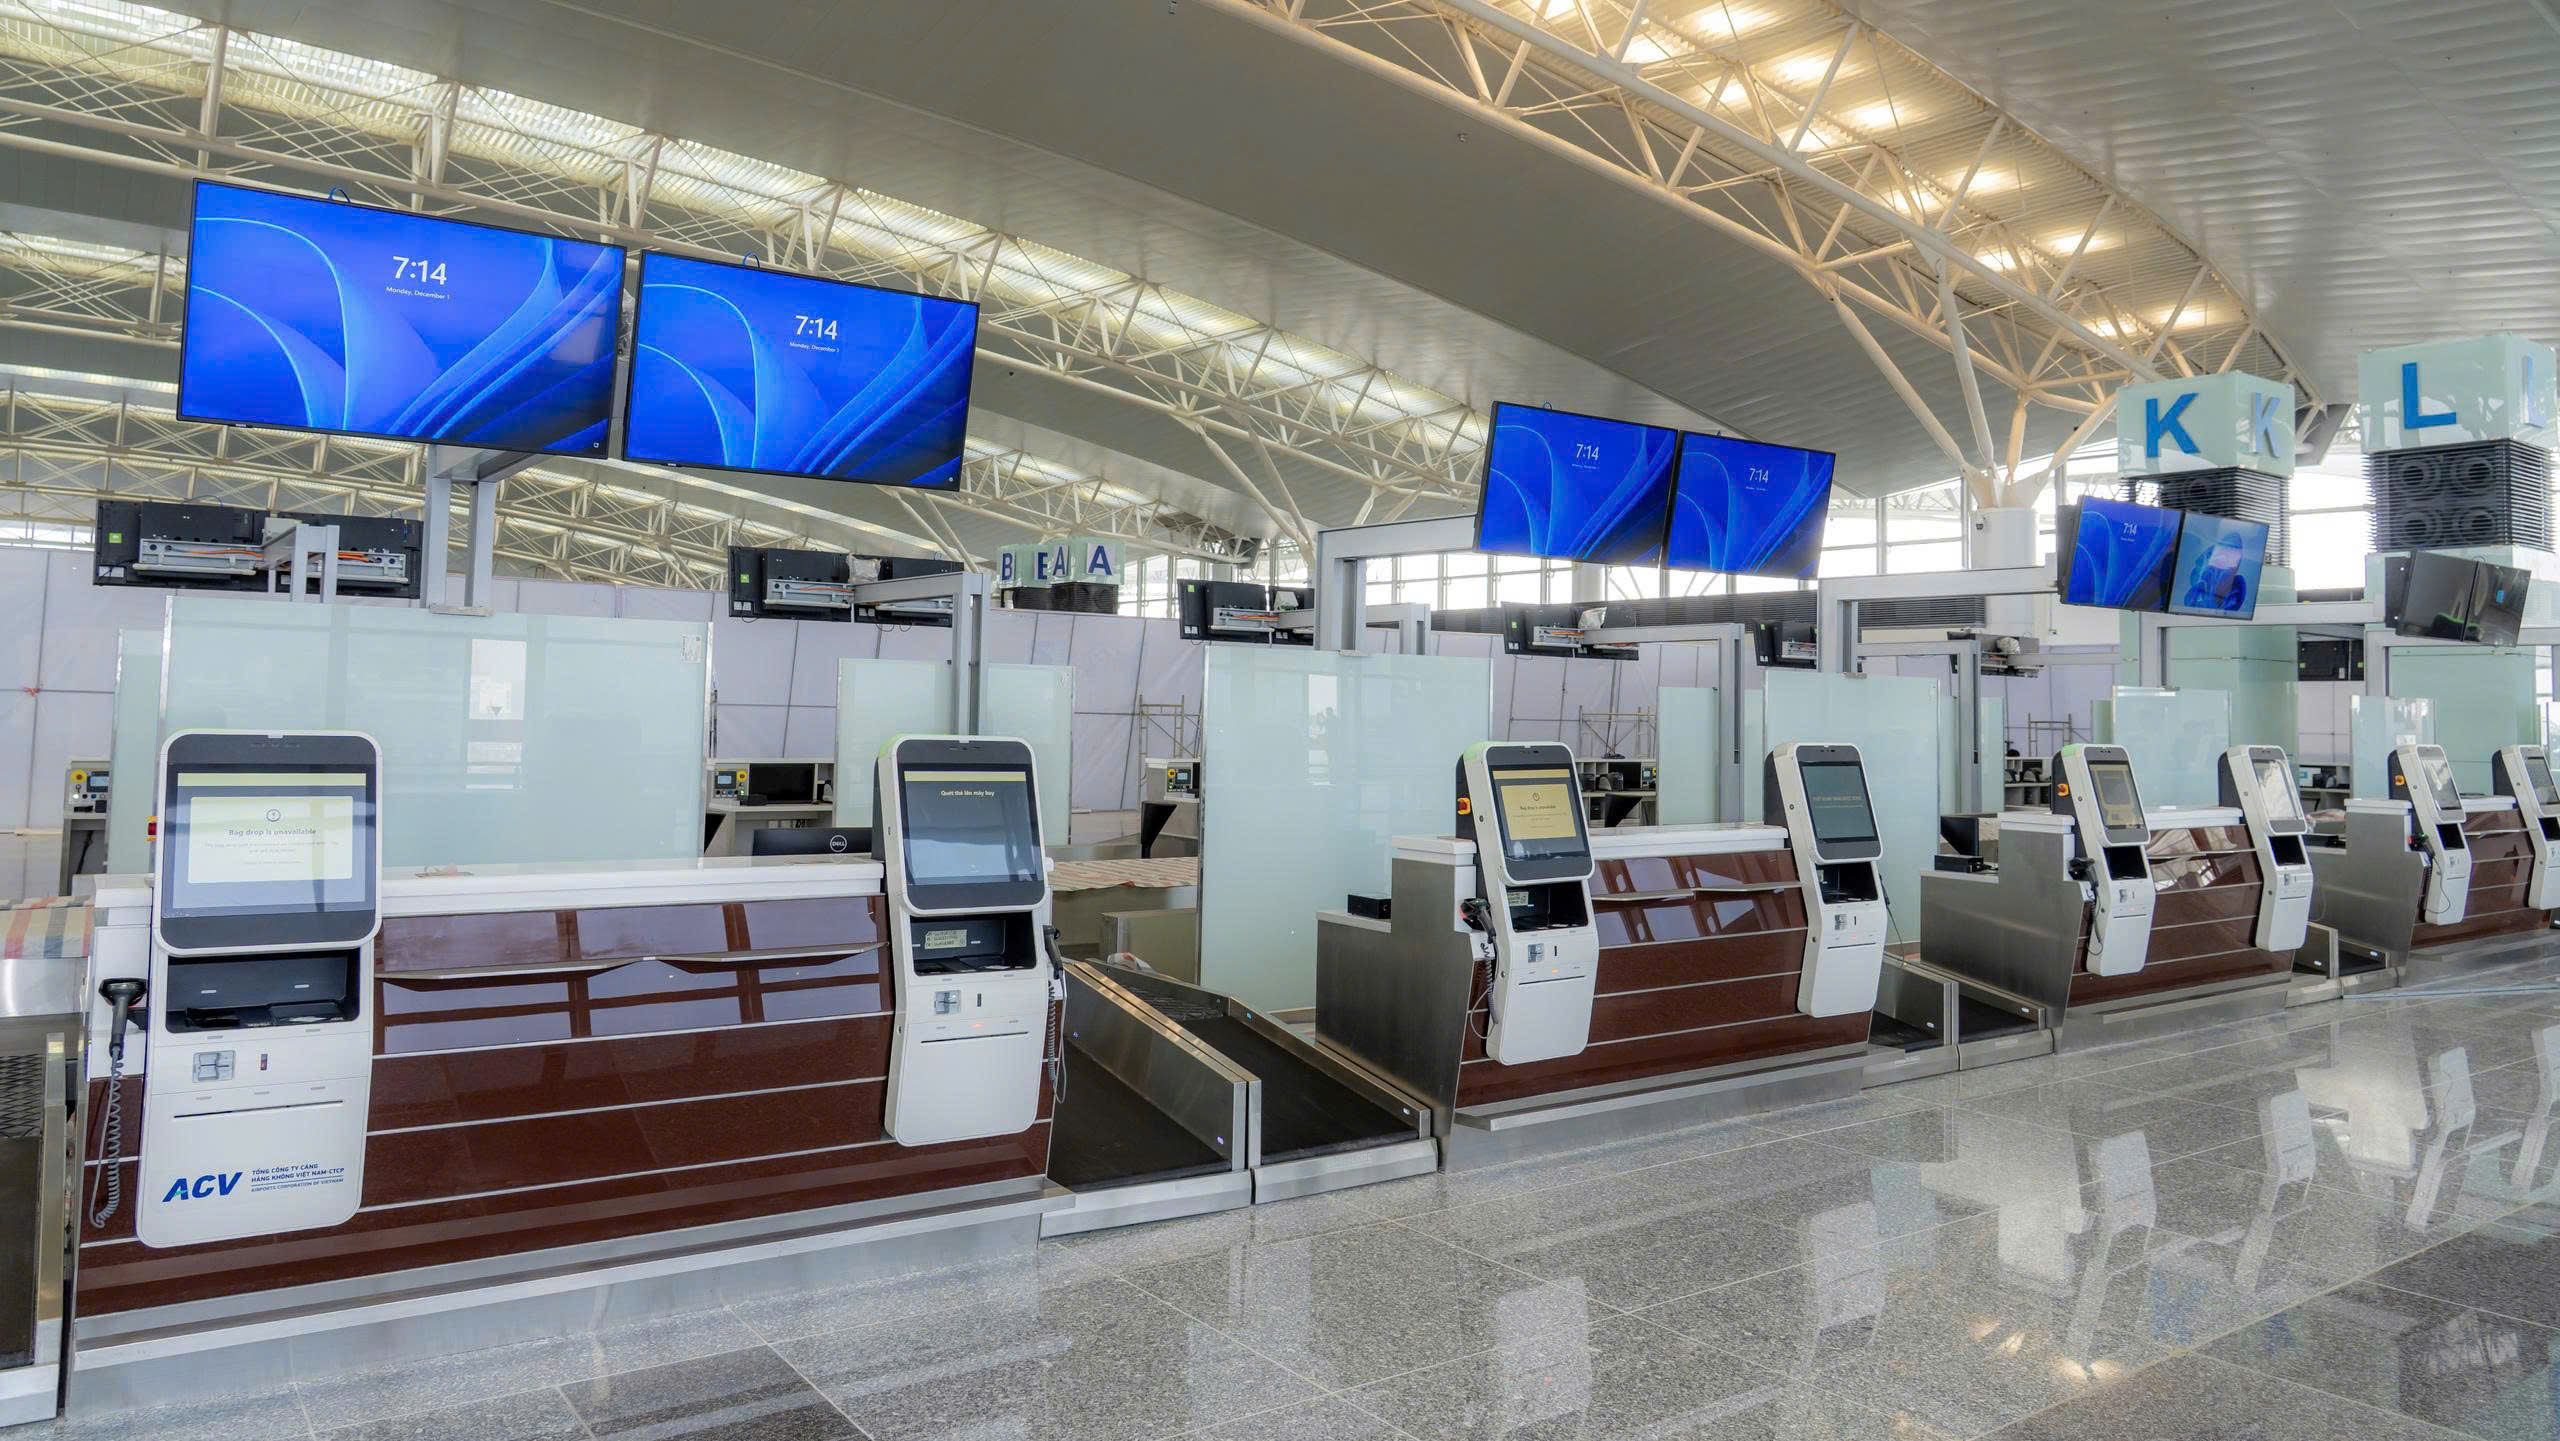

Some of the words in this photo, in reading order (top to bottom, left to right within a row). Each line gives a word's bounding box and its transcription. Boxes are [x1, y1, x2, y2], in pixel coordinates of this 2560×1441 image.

[392, 255, 447, 285] 7:14
[386, 286, 412, 296] Monday,
[414, 290, 445, 299] December
[795, 314, 838, 340] 7:14
[2402, 362, 2457, 429] L
[2146, 392, 2200, 458] K
[2251, 392, 2280, 459] K
[1576, 443, 1599, 461] 7:14
[1749, 467, 1768, 484] 7:14
[1002, 552, 1013, 580] B
[1052, 546, 1066, 576] A
[1087, 545, 1112, 576] A
[229, 829, 244, 837] Bag
[162, 1171, 243, 1203] ACV
